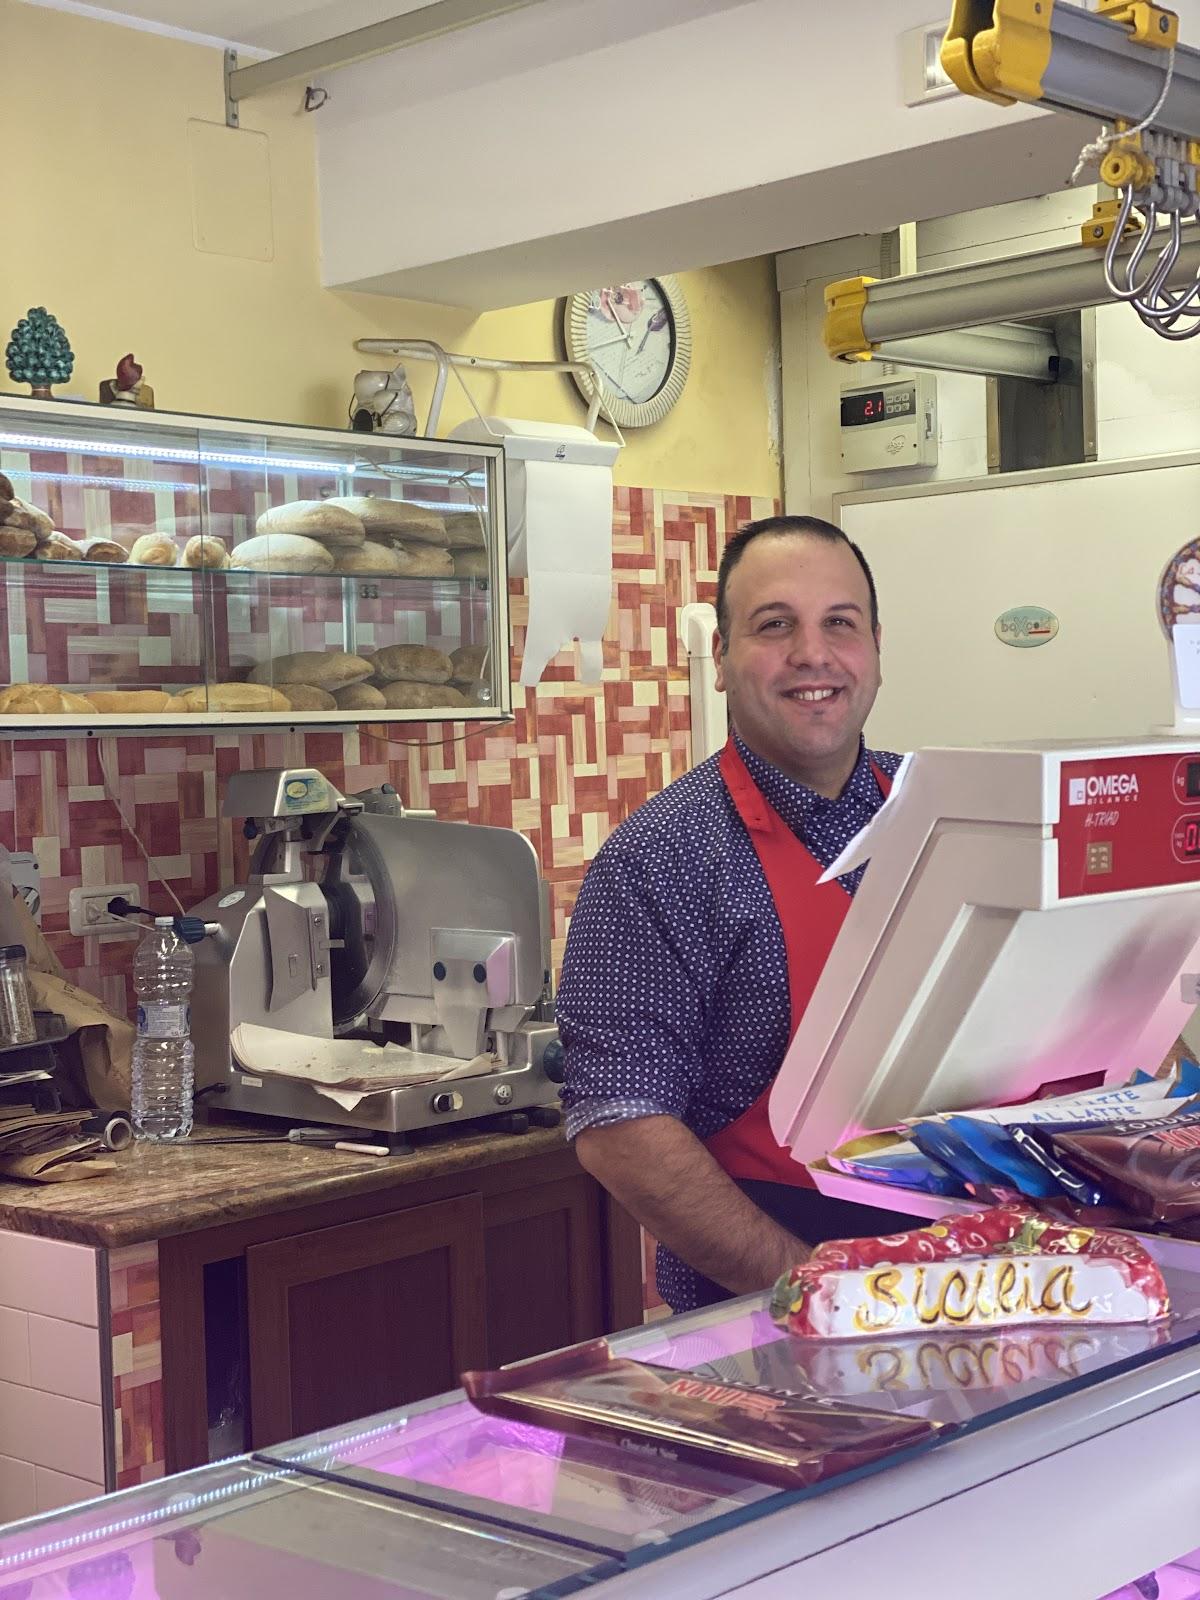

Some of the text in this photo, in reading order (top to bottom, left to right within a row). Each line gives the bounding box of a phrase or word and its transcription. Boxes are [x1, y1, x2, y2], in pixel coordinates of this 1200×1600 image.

[1087, 774, 1139, 797] OMEGA
[1087, 796, 1138, 806] BILANCE
[1032, 1111, 1063, 1122] AL
[1067, 1105, 1142, 1119] LATTE
